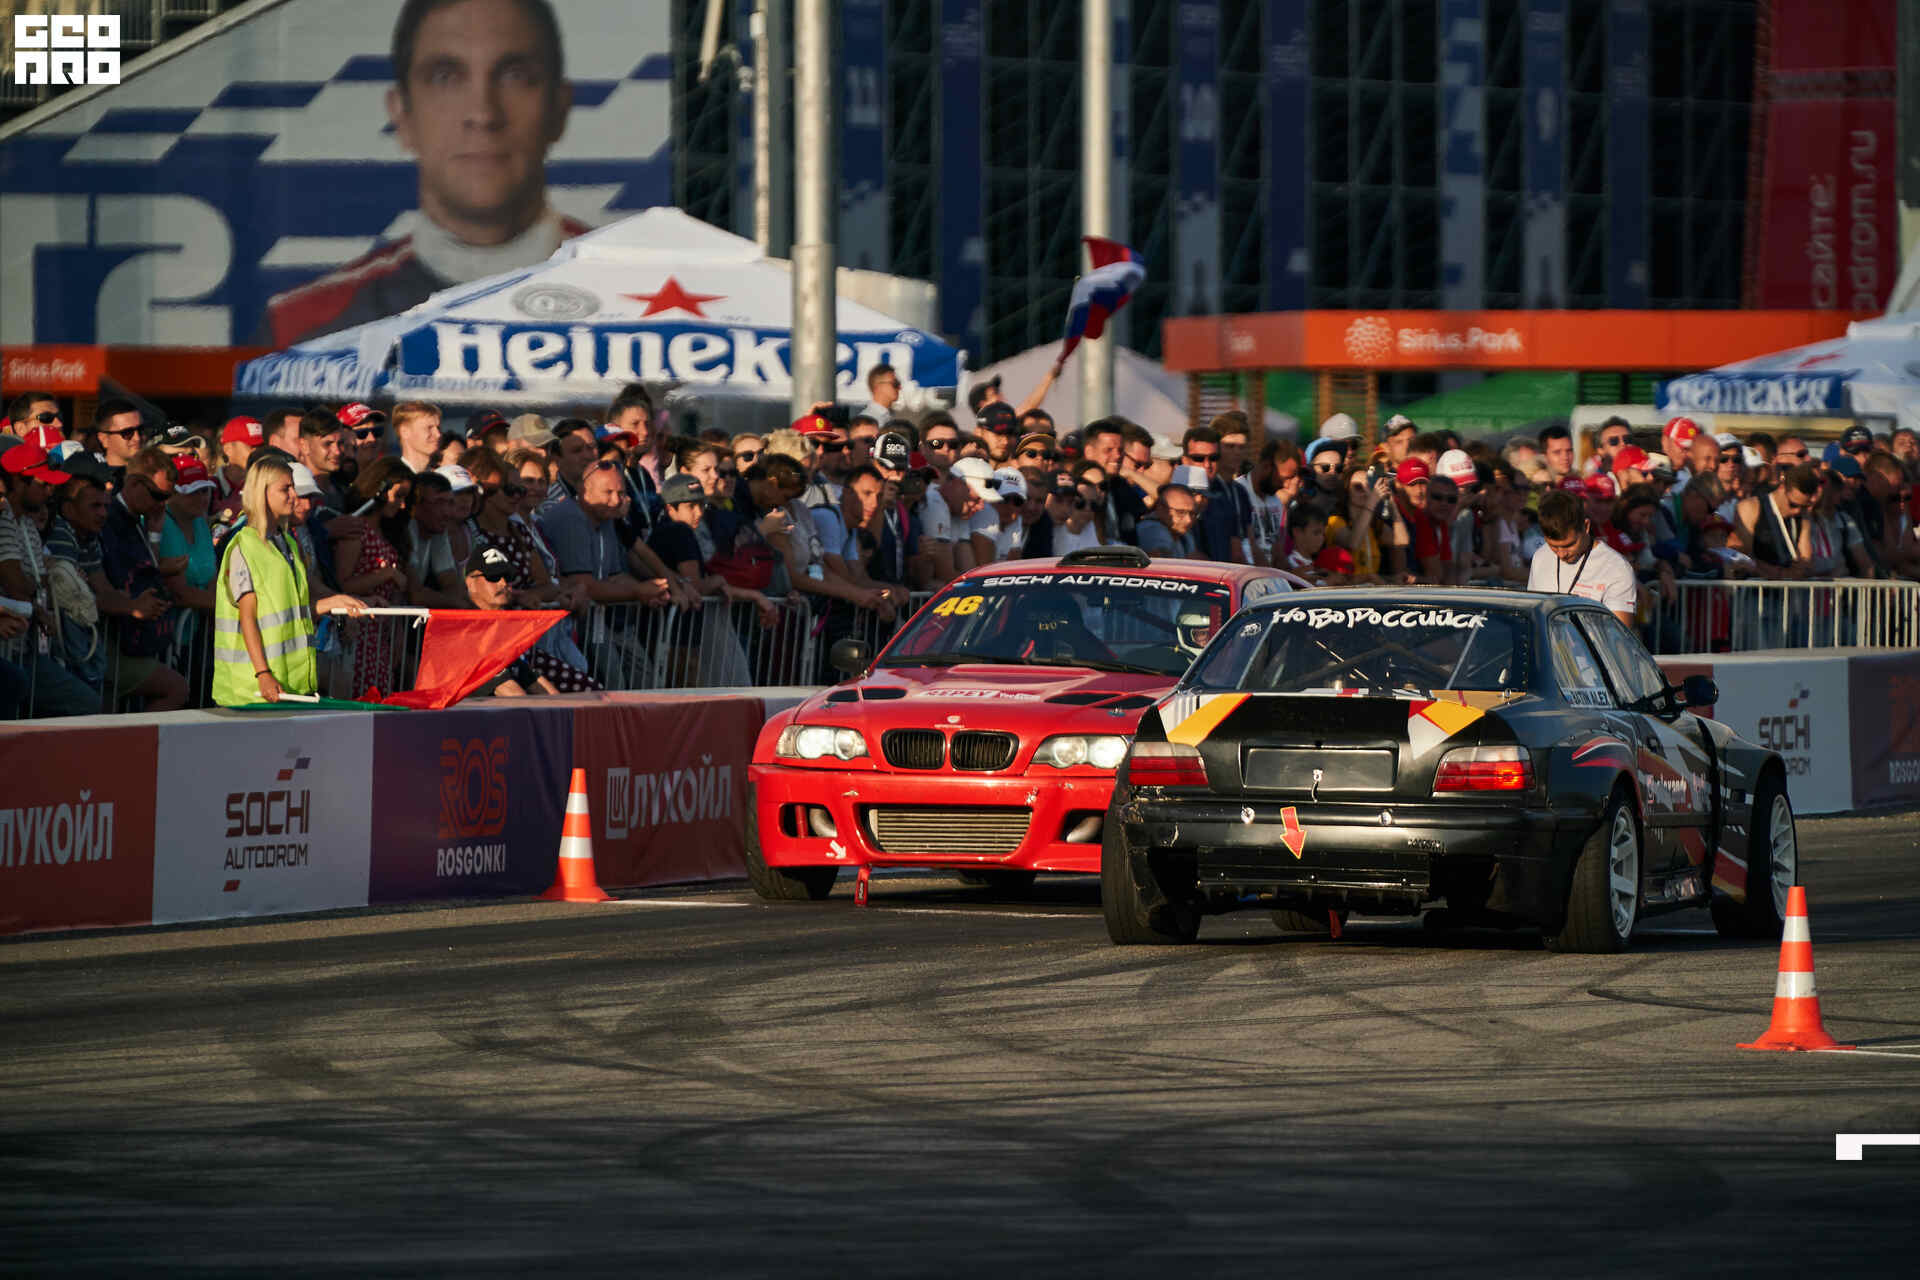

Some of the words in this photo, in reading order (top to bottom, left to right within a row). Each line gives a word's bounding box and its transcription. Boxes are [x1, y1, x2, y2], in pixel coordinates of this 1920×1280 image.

[983, 575, 1052, 587] SOCHI
[1058, 575, 1198, 594] AUTODROM
[932, 595, 984, 617] 46
[0, 788, 114, 868] ЛУКОЙЛ
[225, 789, 311, 838] SOCHI
[223, 843, 309, 872] AUTODROM
[437, 844, 507, 877] ROSGONKI
